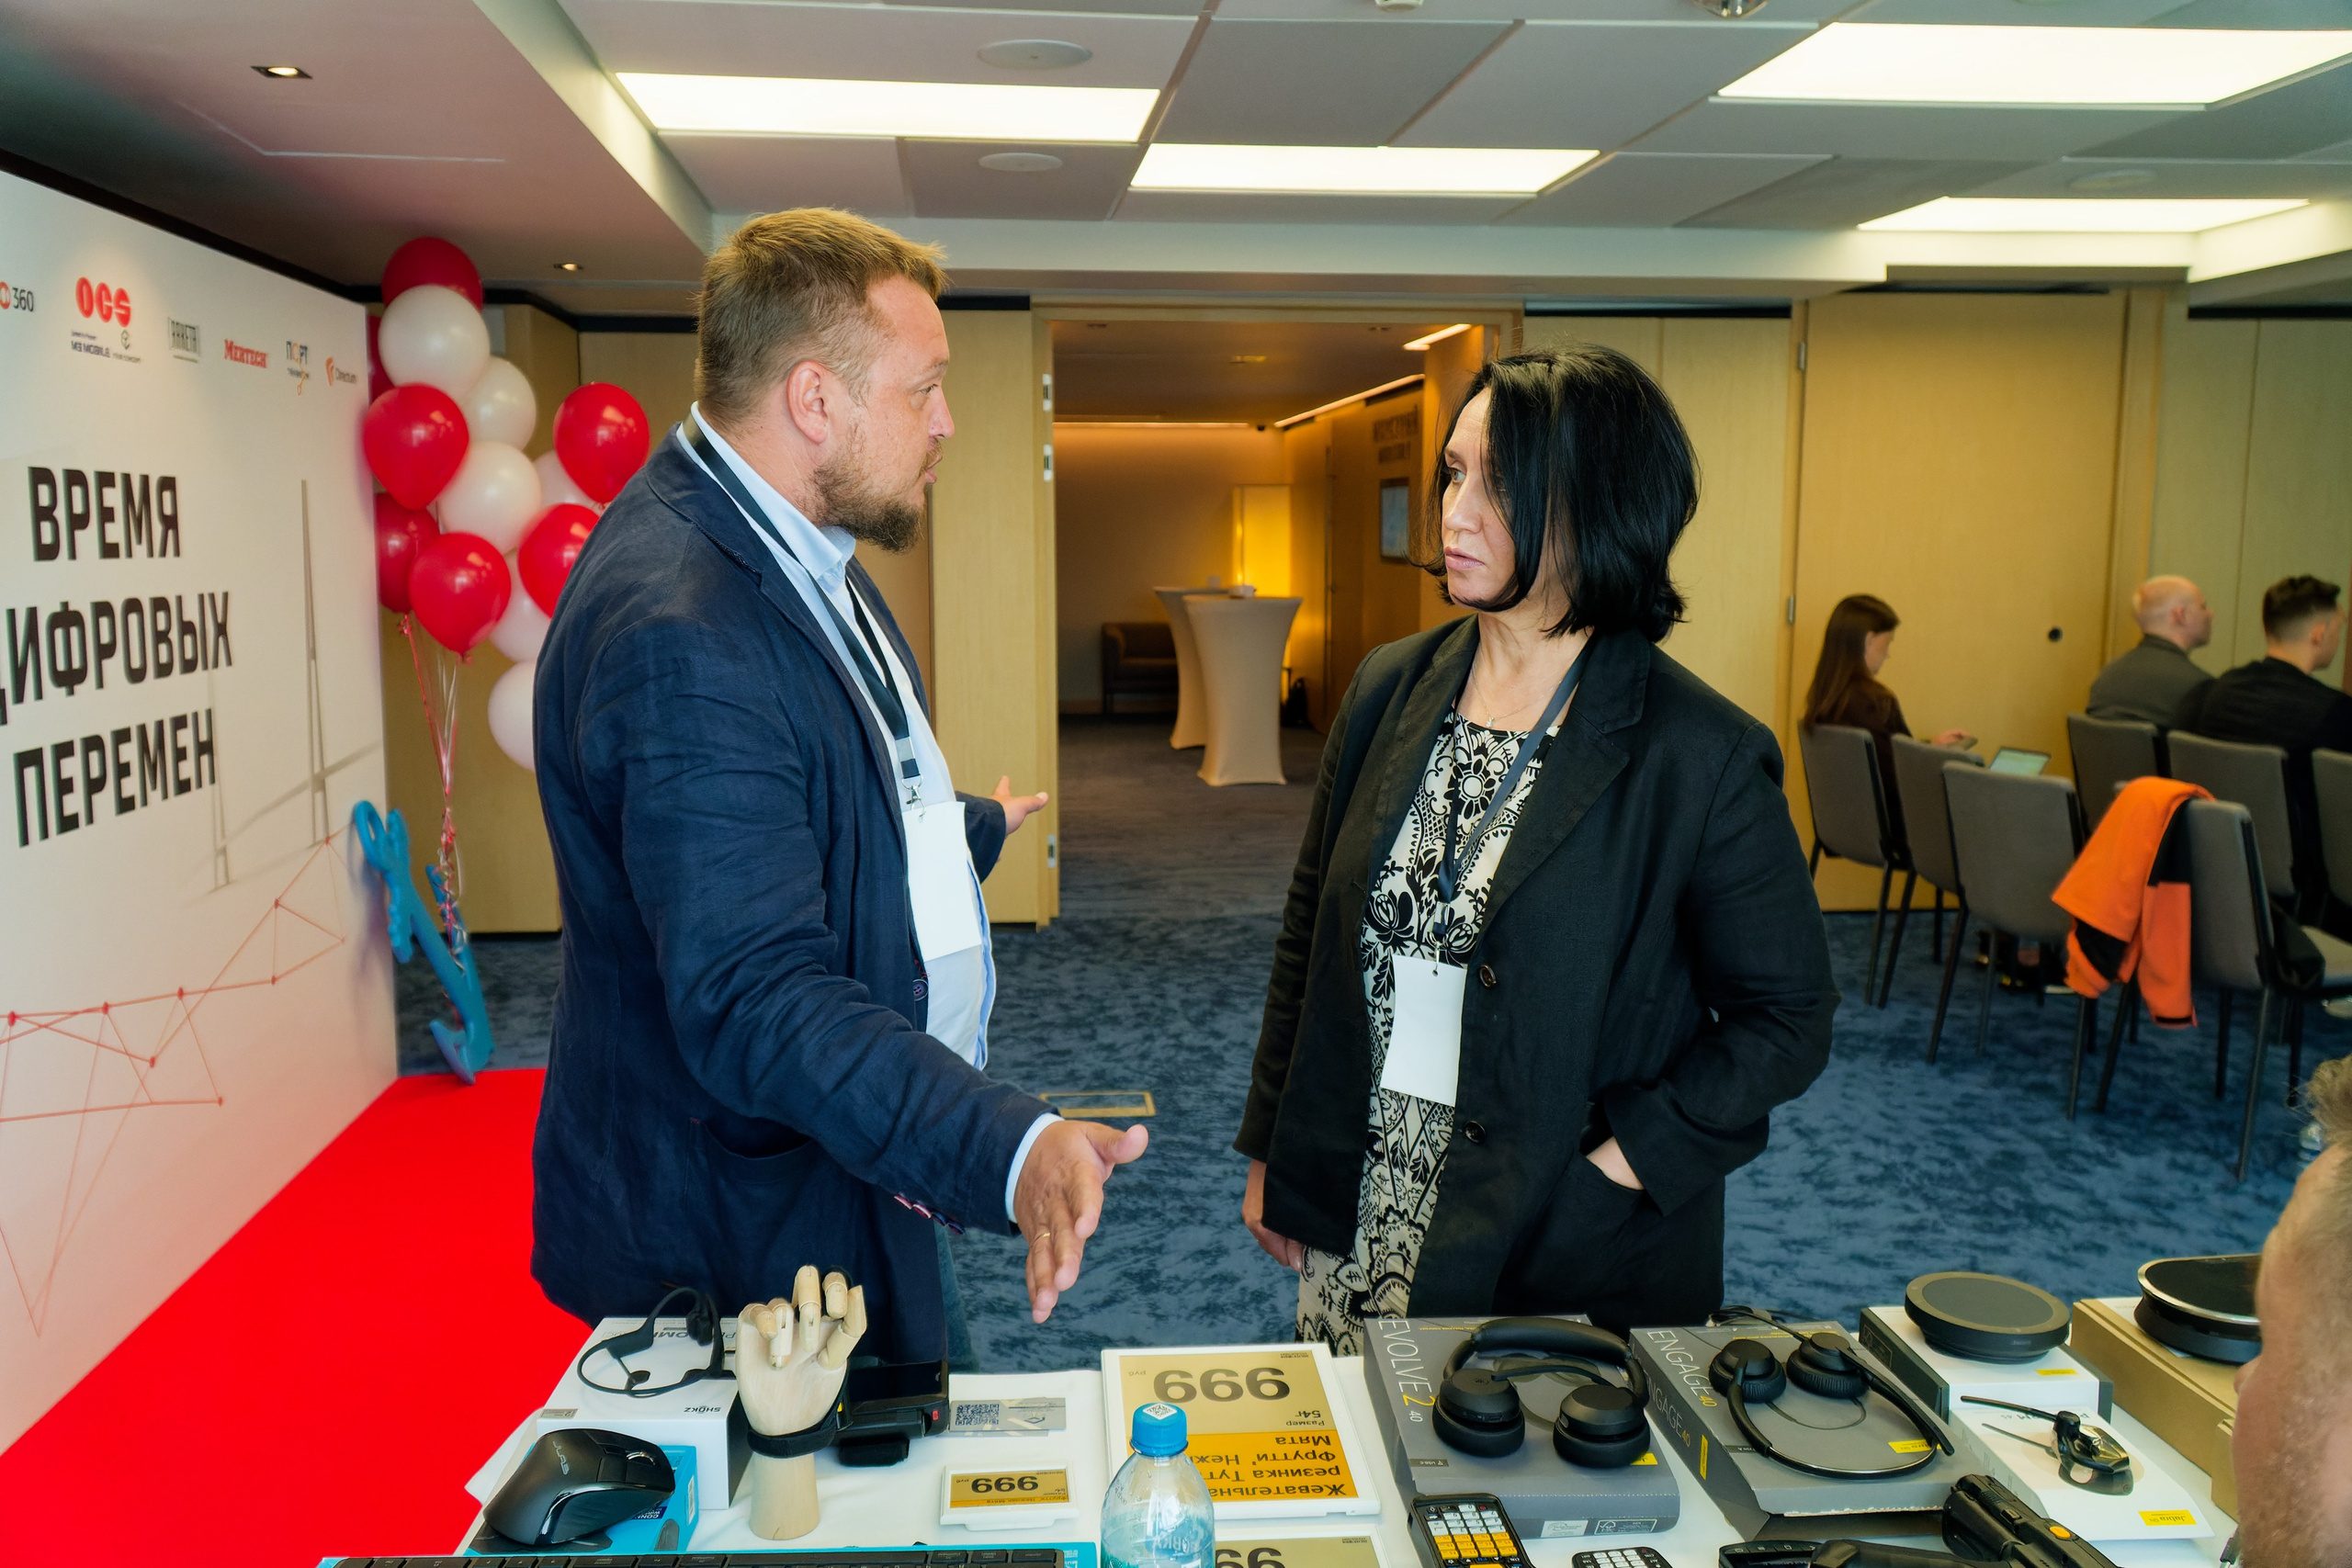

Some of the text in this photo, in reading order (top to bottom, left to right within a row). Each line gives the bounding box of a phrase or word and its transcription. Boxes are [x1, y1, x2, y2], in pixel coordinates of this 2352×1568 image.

[12, 288, 34, 312] 360
[28, 466, 180, 561] ВРЕМЯ
[0, 591, 232, 727] ИФРОВЫХ
[13, 707, 216, 848] ПЕРЕМЕН
[1153, 1367, 1290, 1404] 999
[1285, 1419, 1325, 1427] Размер
[1295, 1410, 1321, 1419] 54г
[1408, 1410, 1423, 1422] 40
[1275, 1435, 1331, 1447] Мята
[1187, 1454, 1240, 1465] Неж
[1199, 1465, 1340, 1482] резинка Тут
[971, 1476, 1039, 1494] 999
[1207, 1483, 1346, 1496] Жевательна
